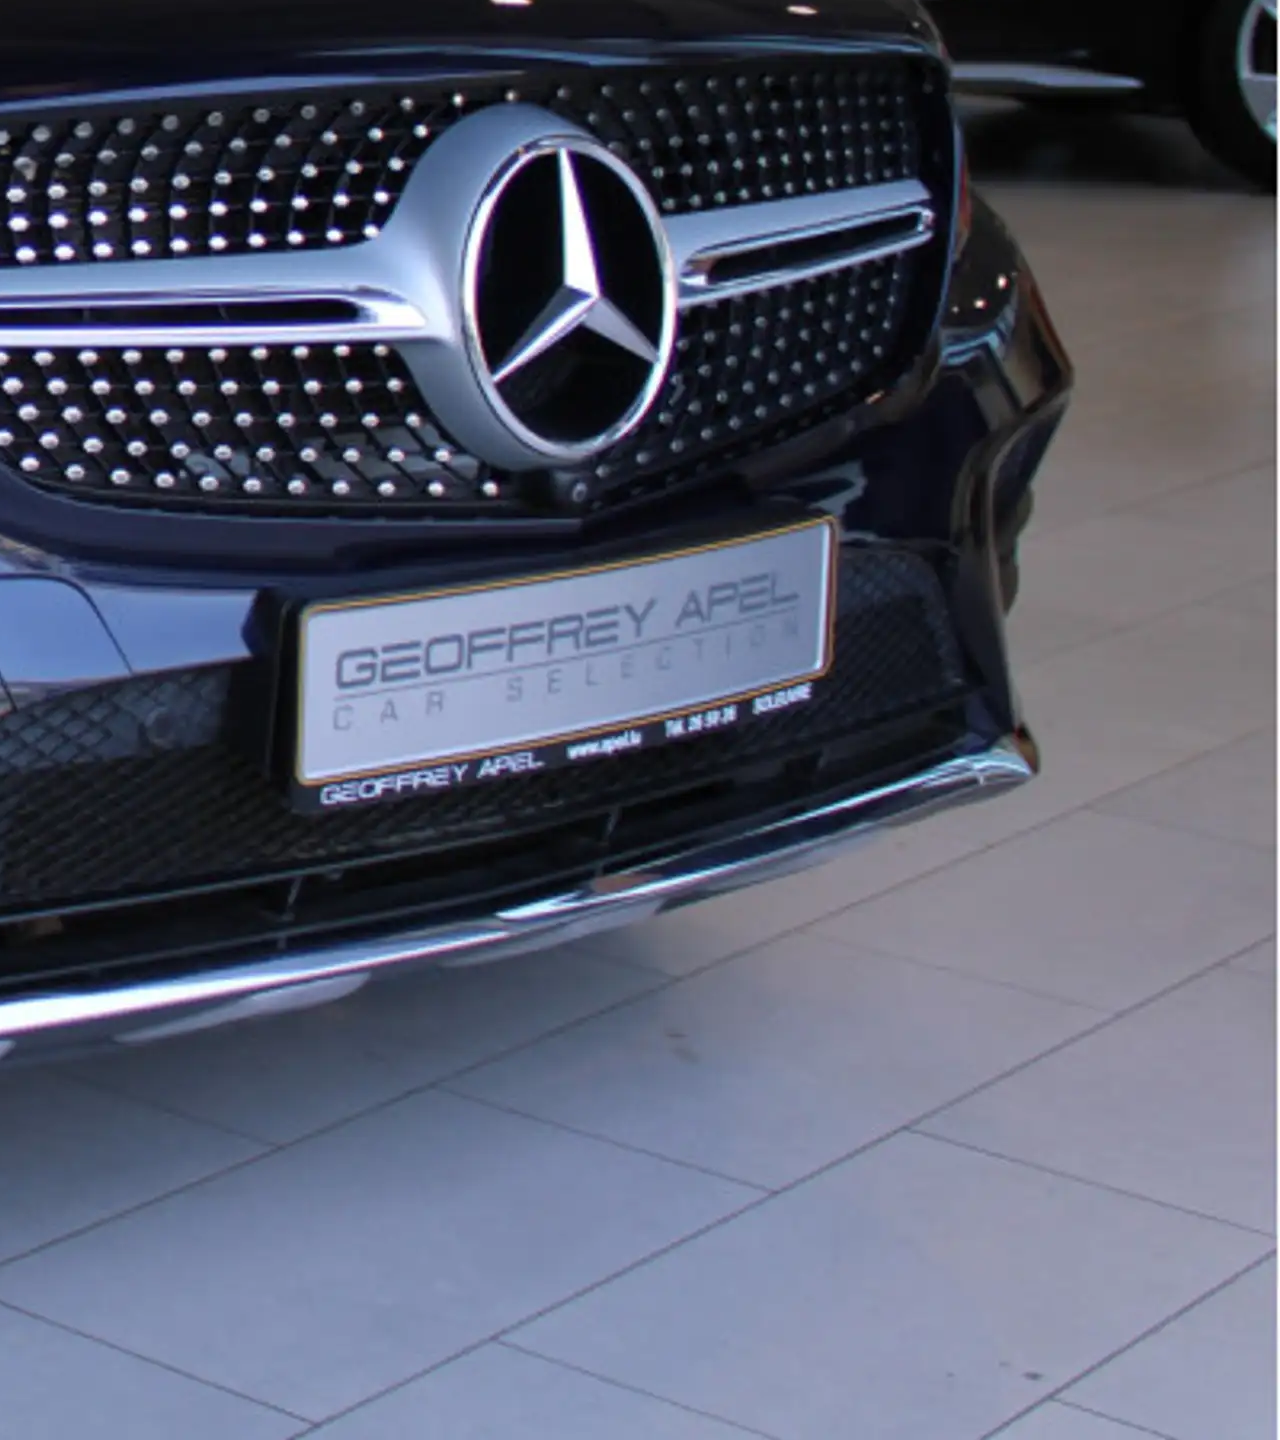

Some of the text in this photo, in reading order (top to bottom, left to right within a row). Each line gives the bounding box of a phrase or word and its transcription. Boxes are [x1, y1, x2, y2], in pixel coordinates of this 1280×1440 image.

[333, 613, 799, 731] CAR SELECTION
[336, 570, 799, 690] GEOFFREY APEL
[320, 763, 468, 805] GEOFFREY
[477, 751, 544, 779] APEL
